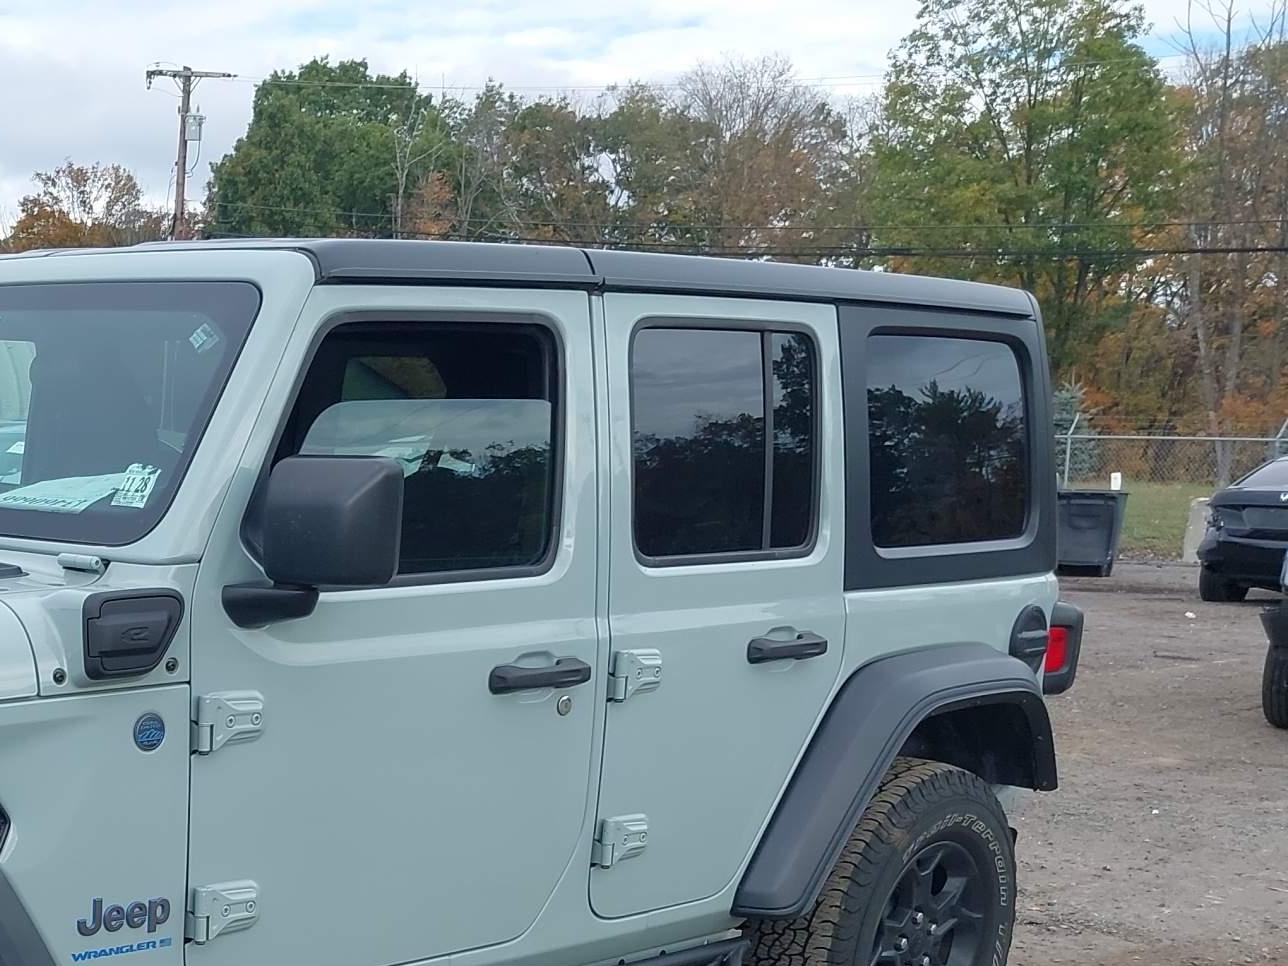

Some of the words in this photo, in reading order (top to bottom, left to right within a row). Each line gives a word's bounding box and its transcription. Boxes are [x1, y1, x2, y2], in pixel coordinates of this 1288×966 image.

[134, 476, 151, 494] 28
[76, 896, 171, 937] Jeep
[72, 940, 157, 963] WRANGLER
